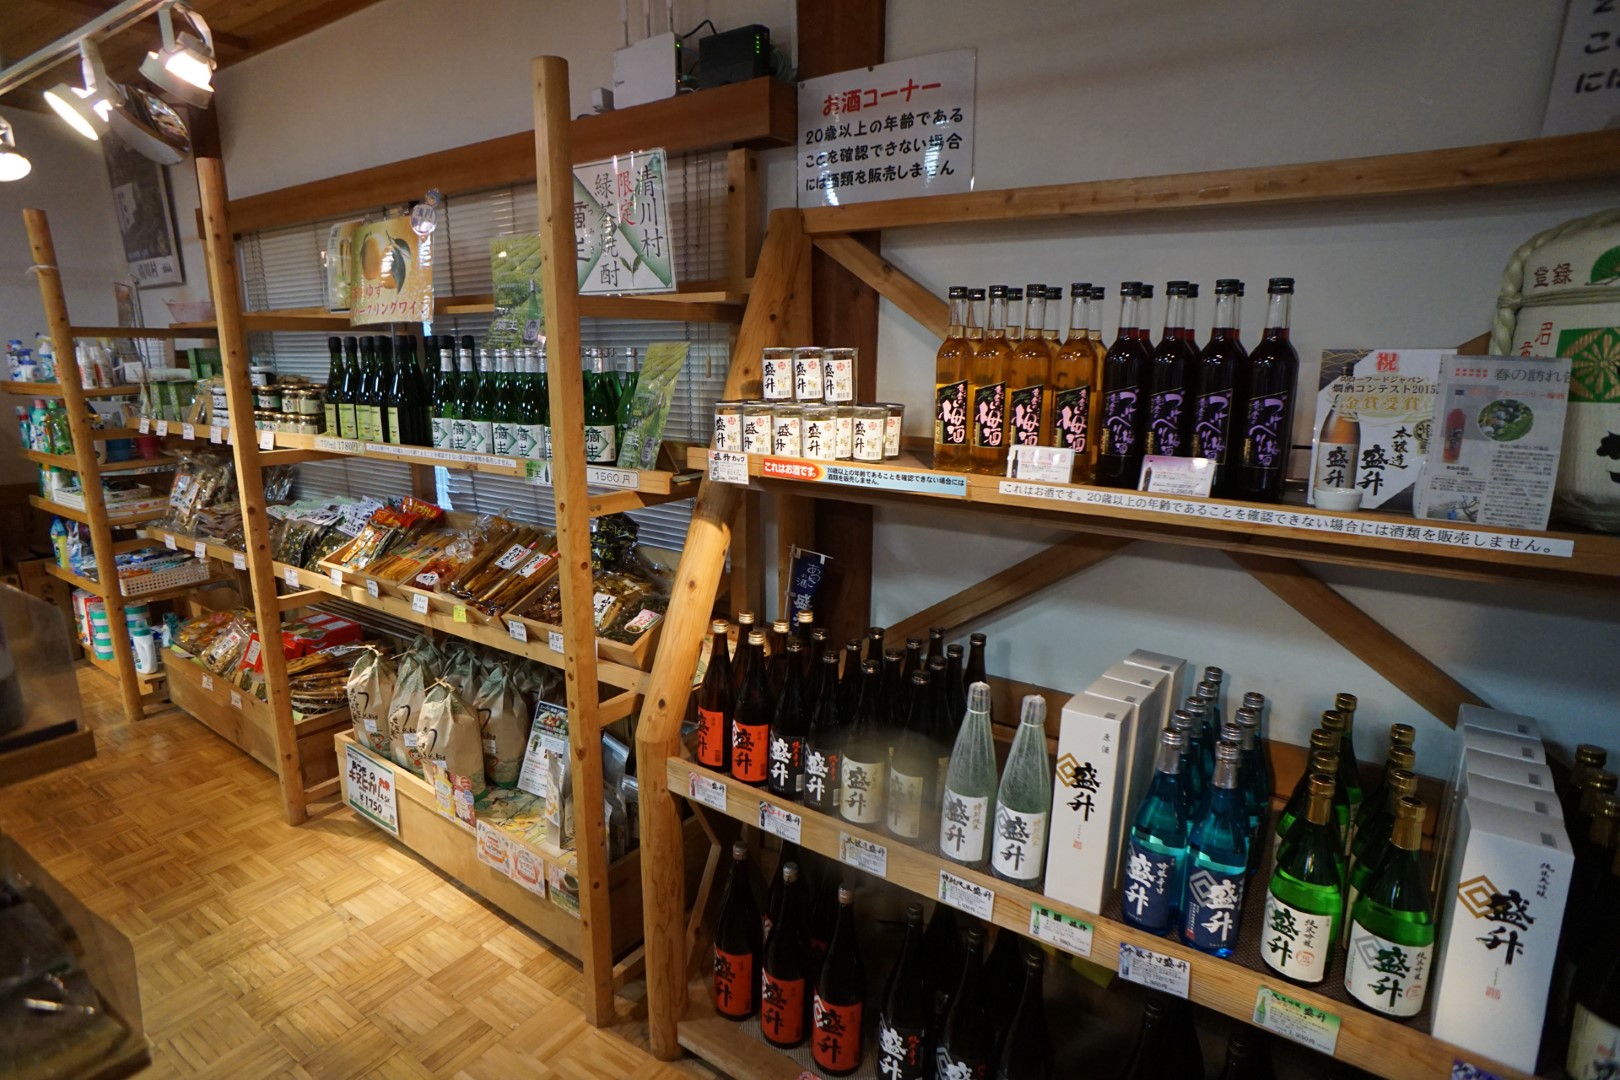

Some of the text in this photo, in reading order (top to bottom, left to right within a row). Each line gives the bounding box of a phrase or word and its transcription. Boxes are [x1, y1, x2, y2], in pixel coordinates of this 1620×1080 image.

[822, 78, 941, 116] お酒コーナー
[805, 108, 963, 144] 20歳以上の年齢である
[805, 132, 963, 168] ことを確認できない場合
[617, 170, 636, 226] 限定
[636, 165, 663, 258] 清川村
[594, 172, 621, 287] 緑茶焼酎
[1533, 262, 1574, 289] 登録
[765, 362, 775, 393] 盛升
[796, 361, 806, 393] 盛升
[824, 362, 834, 395] 盛升
[1376, 352, 1398, 372] 祝
[1342, 396, 1421, 411] 金賞受賞
[716, 416, 726, 448] 盛升
[776, 423, 793, 451] 盛升
[807, 422, 821, 456] 盛升
[855, 420, 866, 454] 盛升
[595, 472, 631, 485] 1560円
[764, 461, 816, 478] これはお酒です。
[827, 467, 965, 487] 20歳以上の年齢であることを確認できない場合には
[1356, 444, 1391, 497] 盛升
[1004, 484, 1552, 554] これはお酒です。20歳以上の年齢であることを確認できない場合には酒類を販売しません。
[734, 728, 755, 775] 盛升
[770, 737, 793, 787] 盛升
[806, 751, 830, 802] 盛升
[846, 766, 871, 817] 盛升
[1066, 762, 1101, 822] 盛升
[944, 797, 970, 852] 盛升
[1000, 815, 1030, 871] 盛升
[1125, 852, 1157, 916] 盛升
[1200, 878, 1239, 942] 盛升
[1303, 917, 1318, 949] 純米吟醸
[1475, 888, 1538, 967] 盛升
[1266, 907, 1302, 967] 盛升
[715, 954, 736, 1008] 盛升
[1367, 946, 1412, 1008] 盛升
[763, 982, 788, 1036] 盛升
[817, 1007, 846, 1065] 盛升
